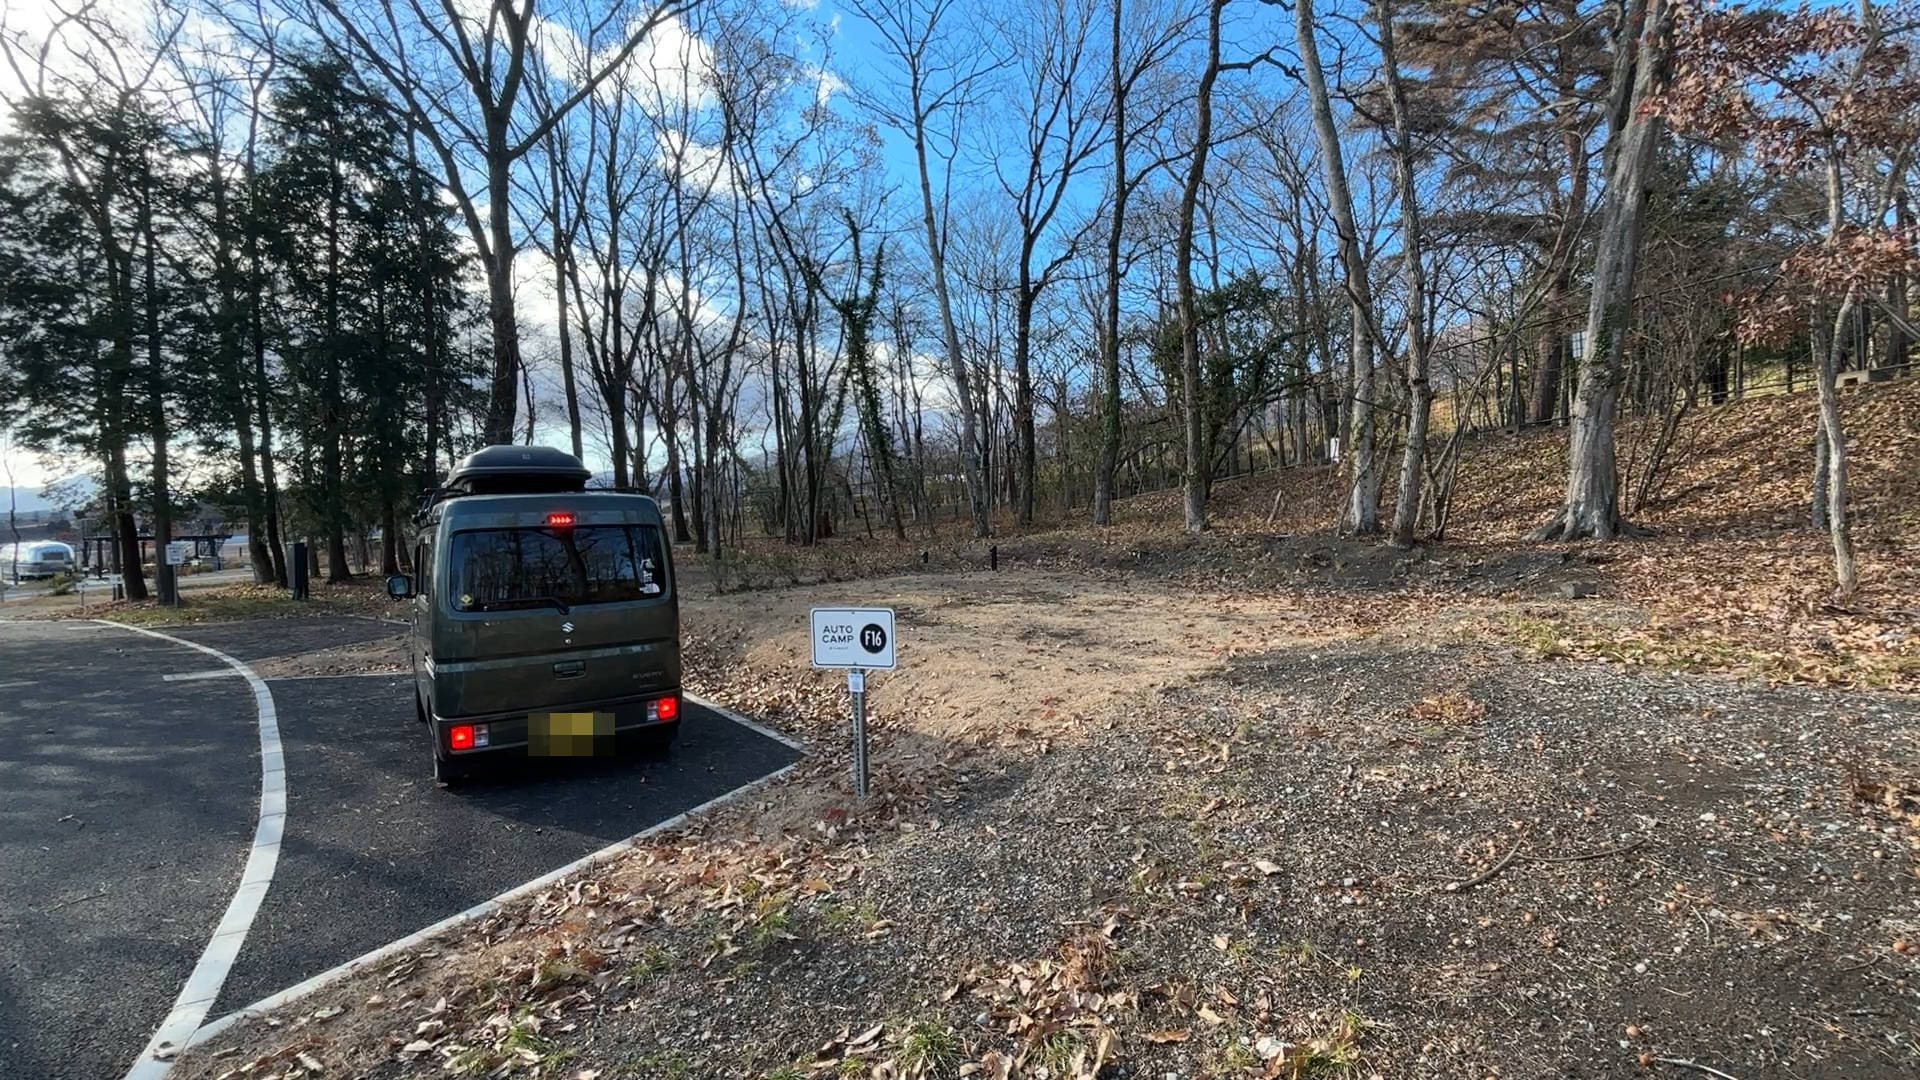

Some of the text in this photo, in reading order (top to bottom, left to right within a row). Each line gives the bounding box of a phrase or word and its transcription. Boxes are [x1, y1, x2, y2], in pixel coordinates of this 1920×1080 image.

[823, 625, 853, 634] AUTO
[822, 635, 854, 643] CAMP
[864, 630, 882, 647] F16
